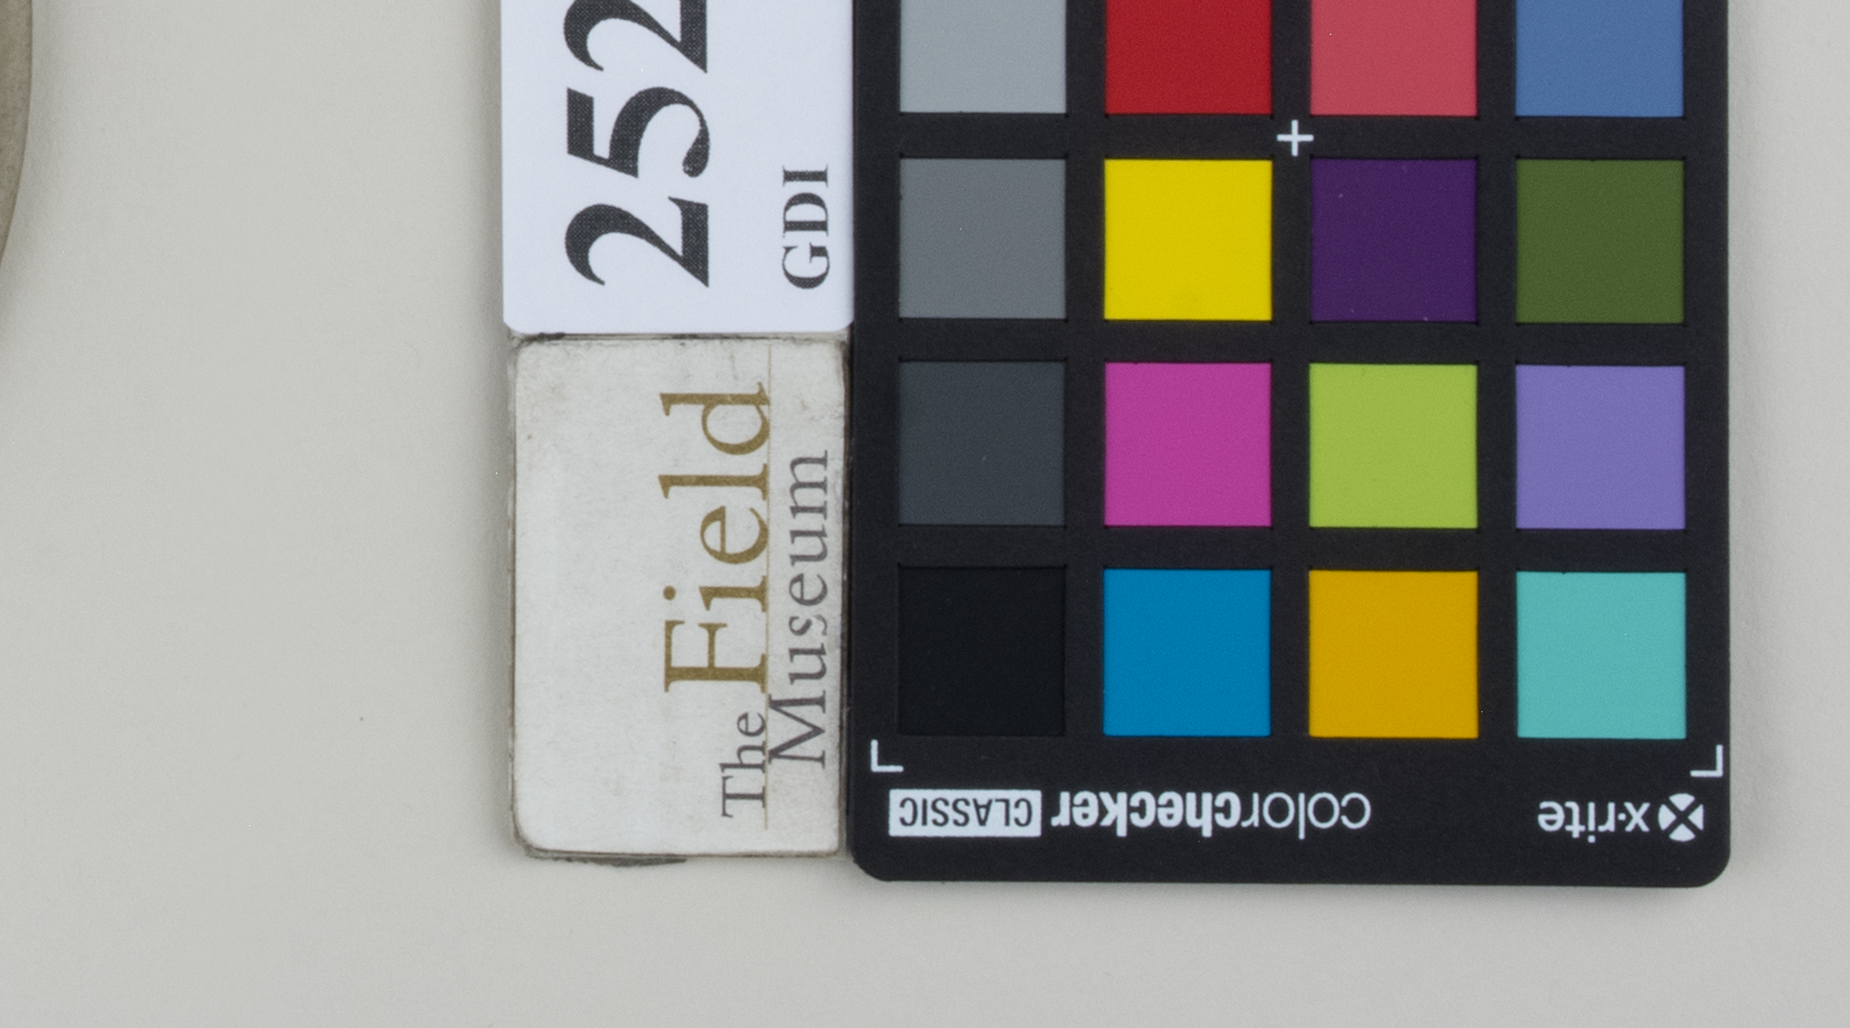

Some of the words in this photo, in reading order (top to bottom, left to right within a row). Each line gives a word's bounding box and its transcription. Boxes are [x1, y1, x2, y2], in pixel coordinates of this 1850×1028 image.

[782, 164, 831, 290] GDI
[657, 382, 771, 693] Field
[767, 450, 829, 769] Museum
[718, 711, 767, 818] The
[898, 796, 1034, 827] CLASSIC
[1050, 790, 1372, 840] colorchecker
